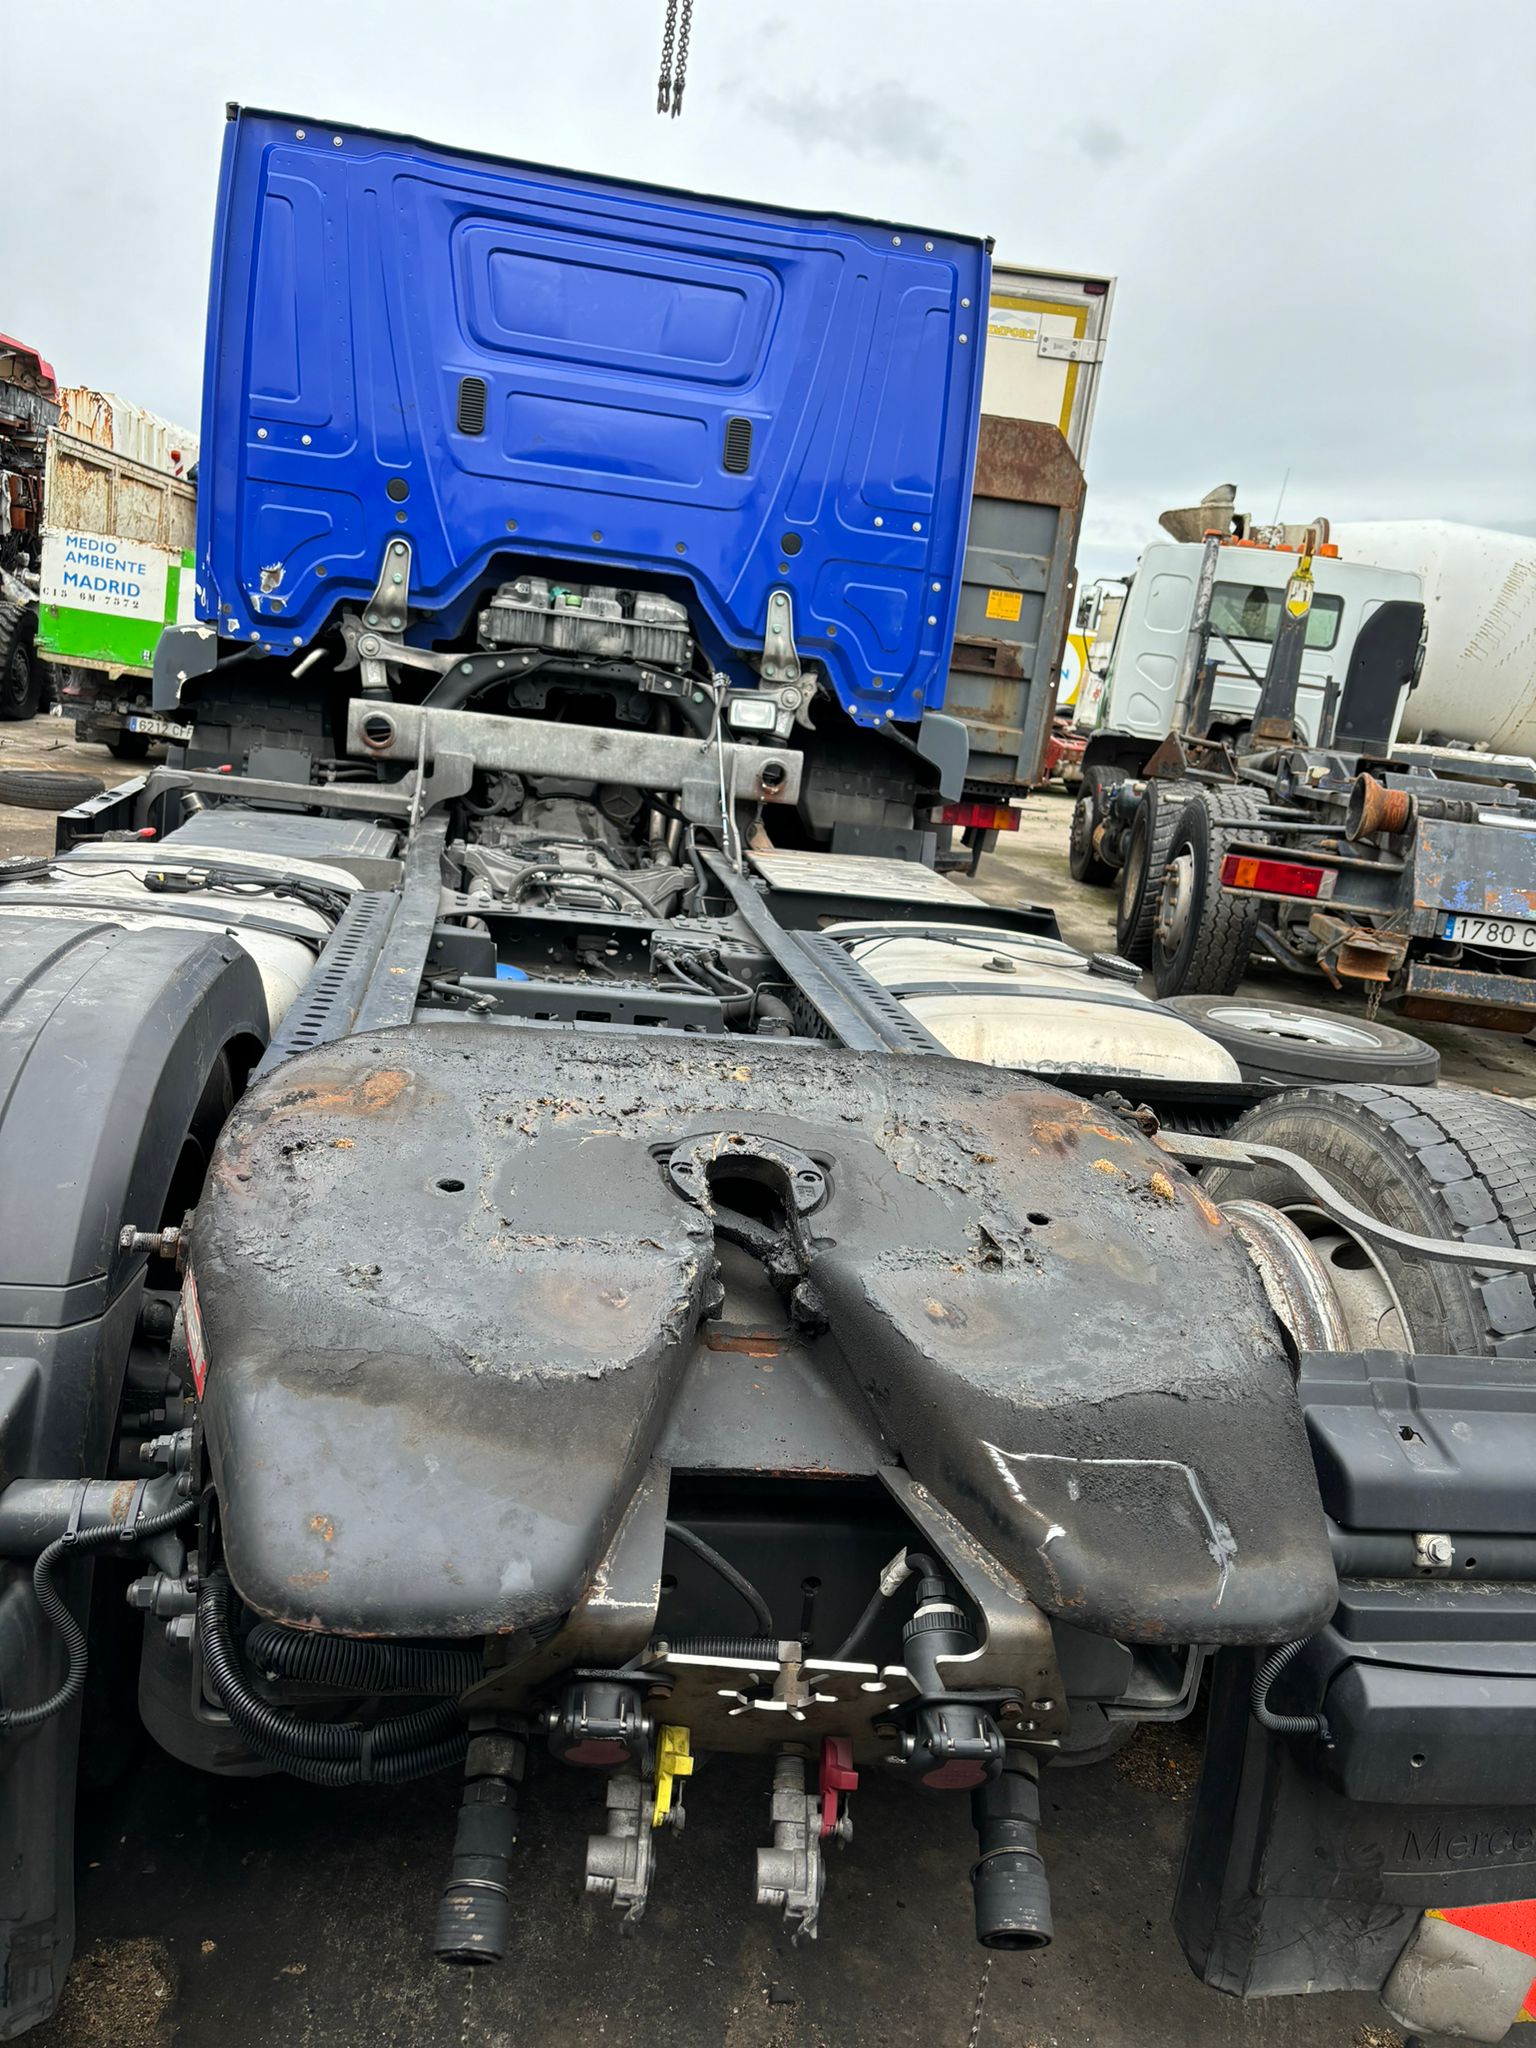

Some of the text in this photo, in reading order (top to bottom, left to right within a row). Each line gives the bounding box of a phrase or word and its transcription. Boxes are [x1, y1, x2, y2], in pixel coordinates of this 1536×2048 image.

[66, 535, 117, 554] MEDIO
[65, 551, 146, 575] AMBIENTE
[63, 571, 140, 597] MADRID
[139, 720, 168, 736] 6212
[1461, 919, 1515, 944] 1780
